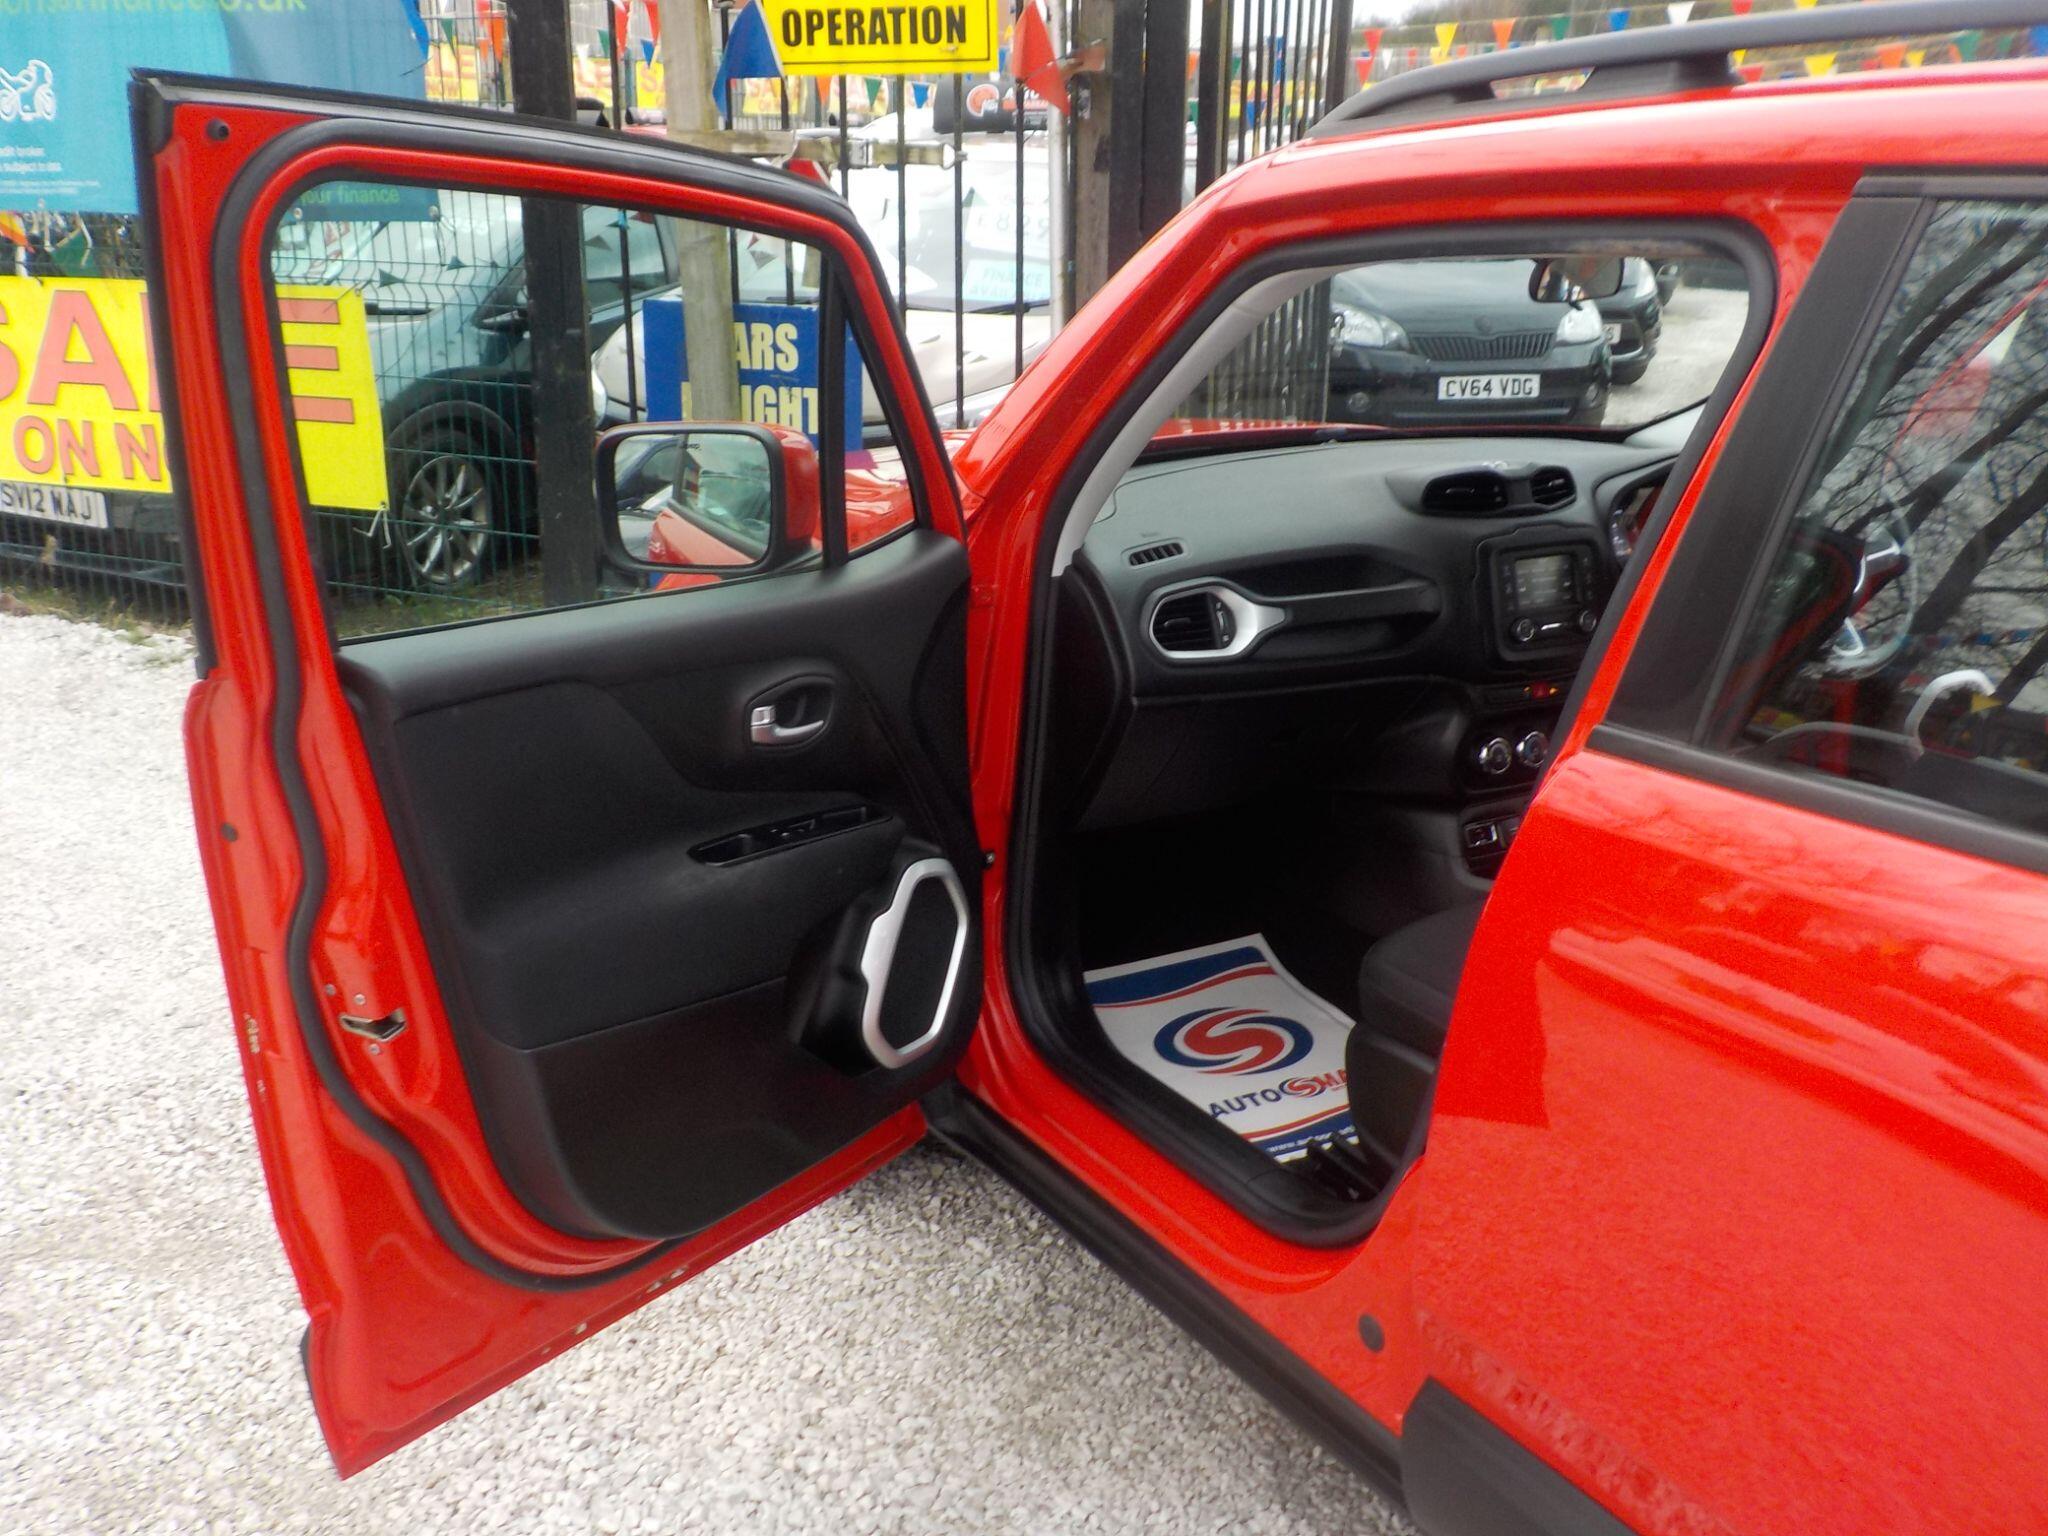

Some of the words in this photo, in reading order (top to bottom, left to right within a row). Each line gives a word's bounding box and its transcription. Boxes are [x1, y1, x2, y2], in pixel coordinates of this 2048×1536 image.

[782, 5, 967, 47] OPERATION
[337, 185, 400, 205] finance
[1446, 379, 1492, 398] CV64
[1500, 378, 1534, 397] VDG
[13, 415, 102, 478] ON
